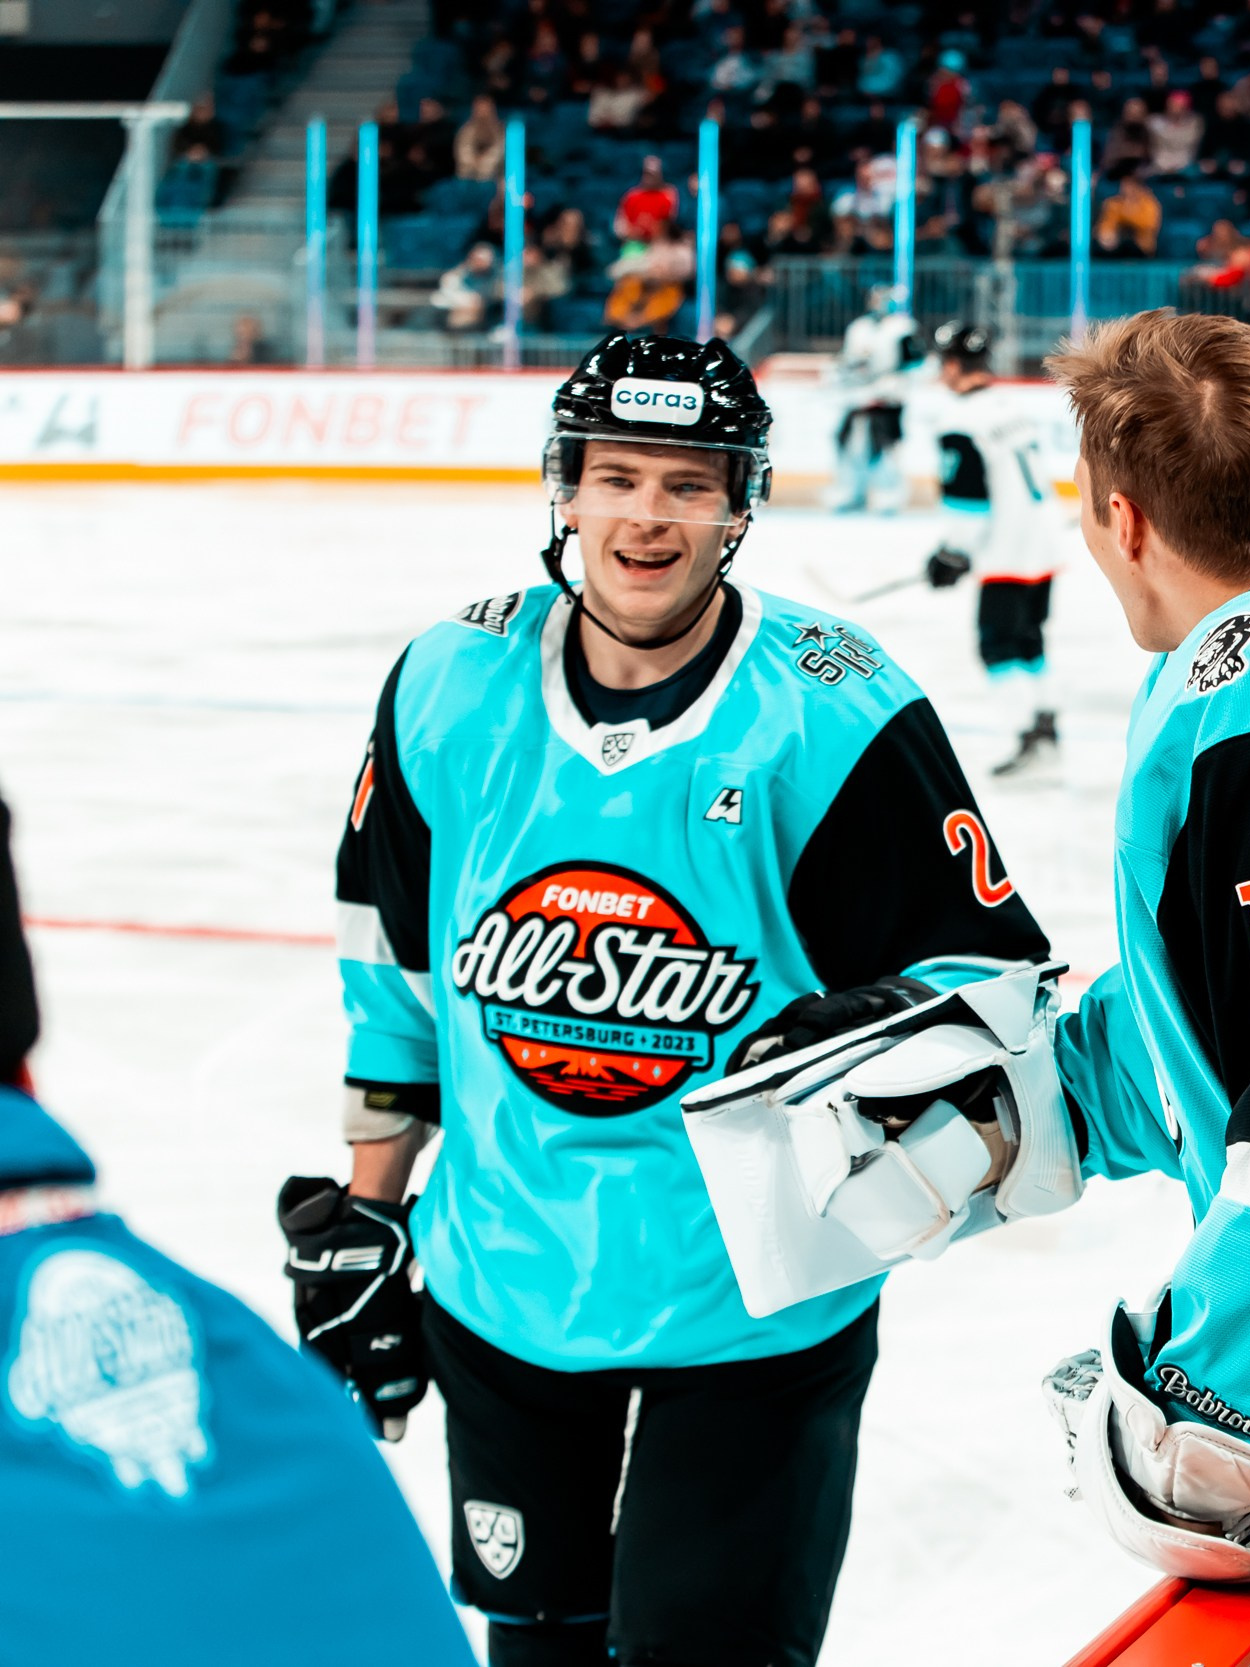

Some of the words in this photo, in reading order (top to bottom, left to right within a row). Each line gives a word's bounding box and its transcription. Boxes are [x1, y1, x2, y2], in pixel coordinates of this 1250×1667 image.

[174, 394, 487, 449] FONBET
[541, 884, 655, 920] FONBET
[452, 911, 751, 1024] All-Star
[522, 1016, 635, 1047] PETERSBURG
[652, 1034, 696, 1051] 2023
